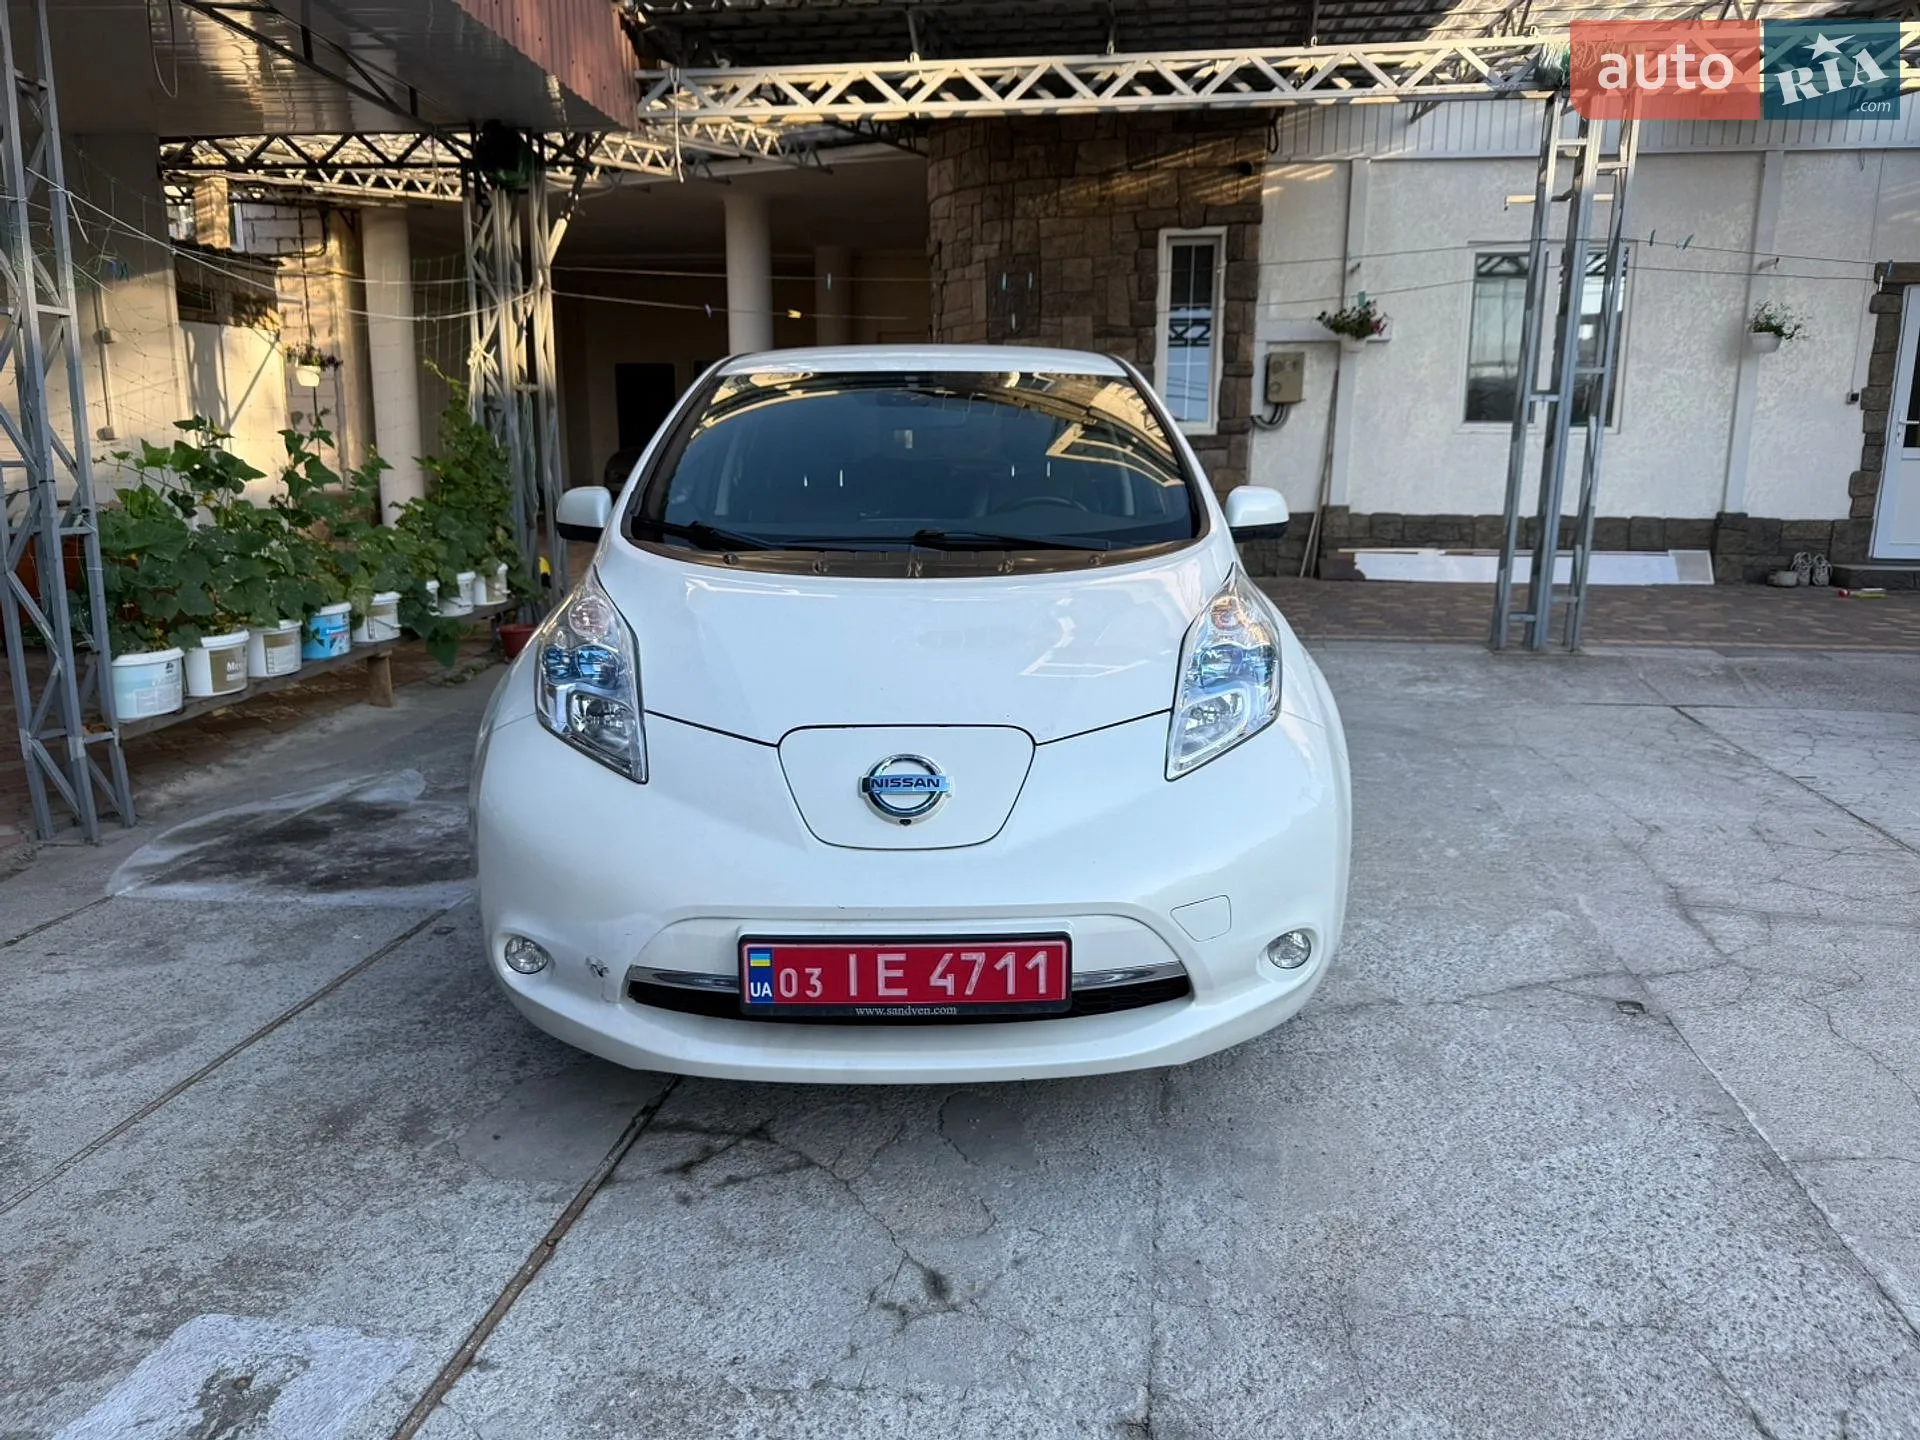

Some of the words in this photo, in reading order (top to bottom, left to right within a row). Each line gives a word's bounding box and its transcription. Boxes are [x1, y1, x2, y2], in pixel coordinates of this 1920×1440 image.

[871, 776, 940, 788] NISSAN
[779, 968, 823, 998] 03
[849, 953, 908, 997] IE
[928, 950, 1047, 996] 4711
[750, 981, 773, 998] UA
[855, 1005, 957, 1017] www.sandven.com
